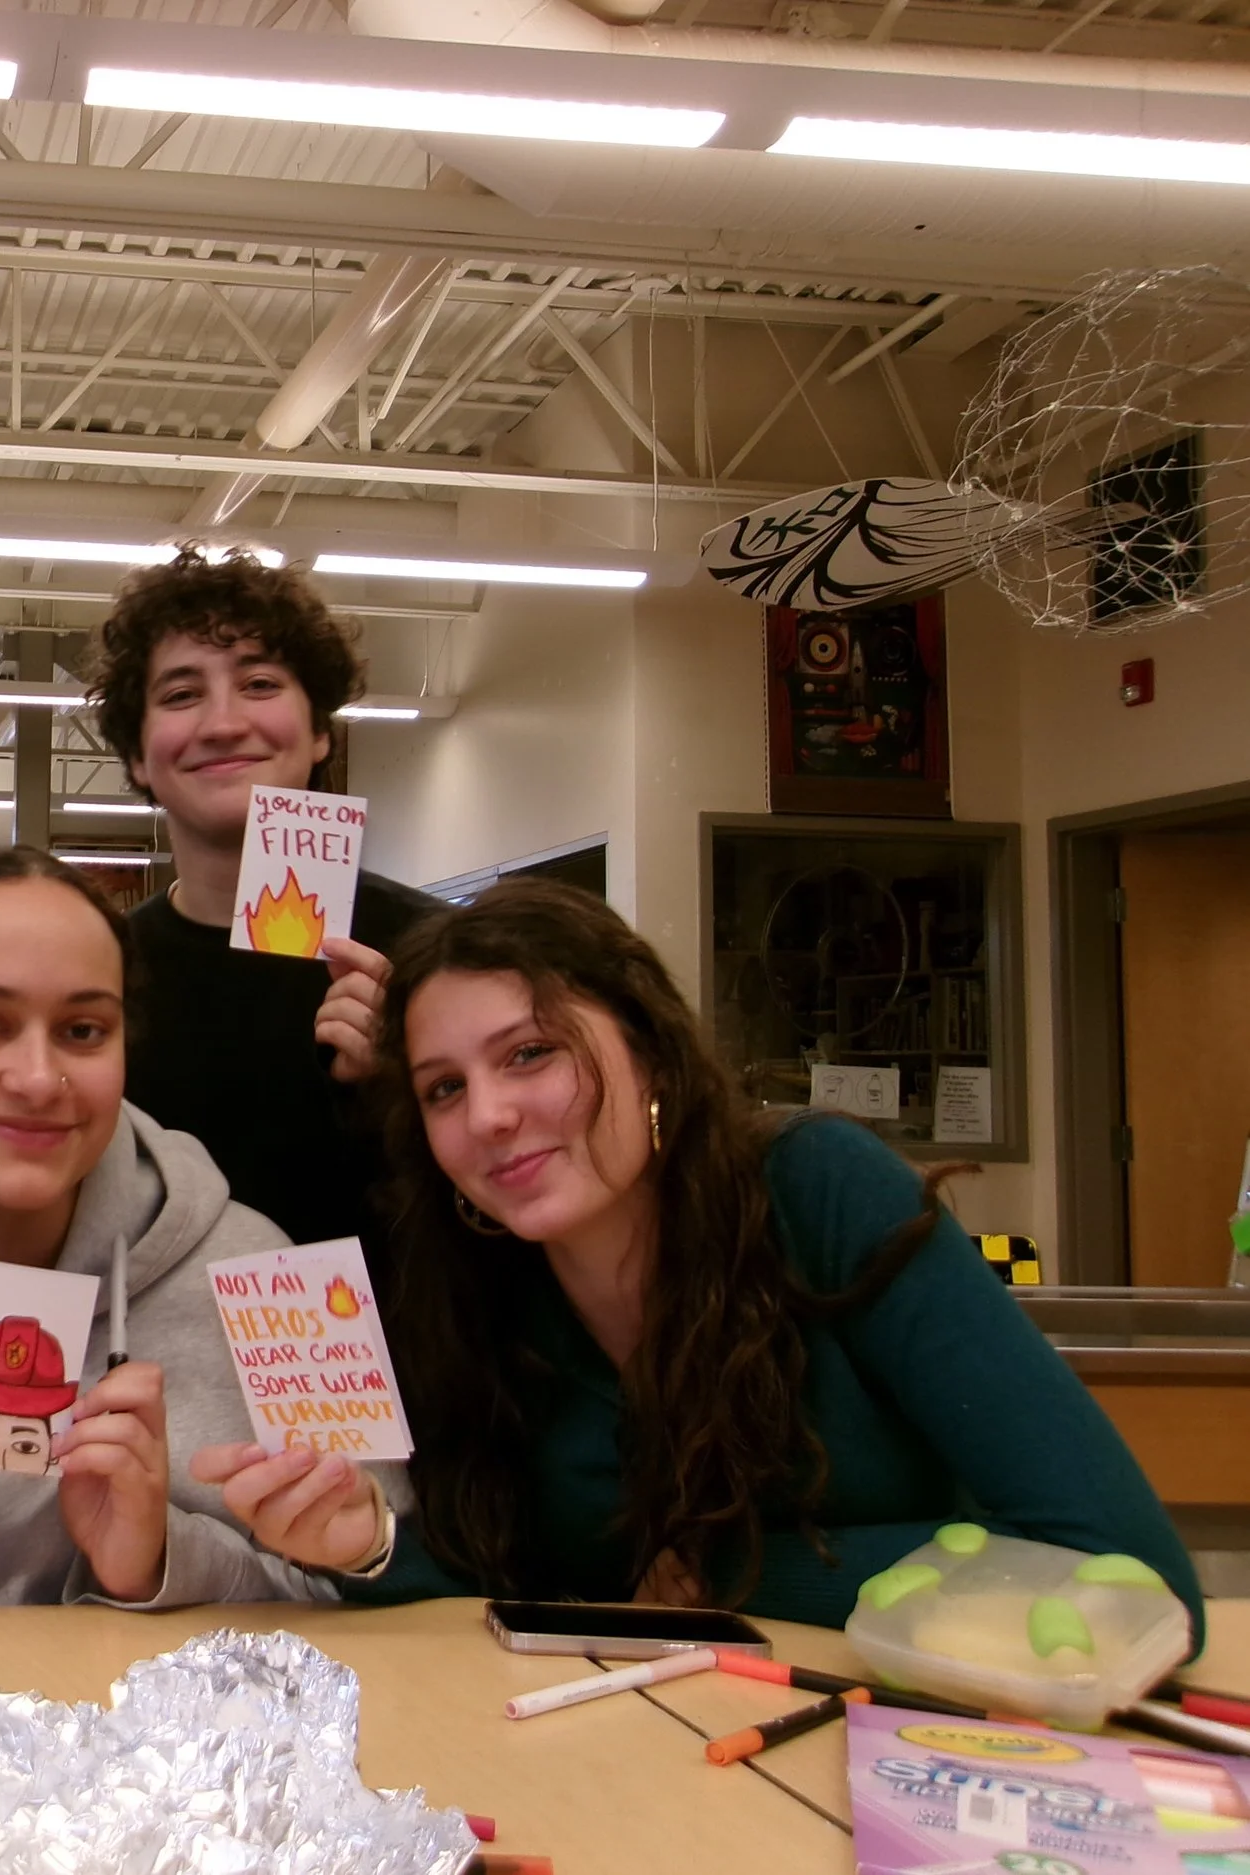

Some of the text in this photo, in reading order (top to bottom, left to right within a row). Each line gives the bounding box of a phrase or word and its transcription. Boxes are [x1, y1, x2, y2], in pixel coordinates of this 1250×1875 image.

[255, 793, 366, 828] you're on
[261, 827, 350, 865] FIRE!
[214, 1271, 263, 1298] NOT
[221, 1305, 326, 1341] HEROS
[234, 1343, 302, 1367] WEAR
[248, 1369, 387, 1397] SOME WEAR
[255, 1399, 393, 1427] TURNOUT
[284, 1428, 372, 1454] GEAR
